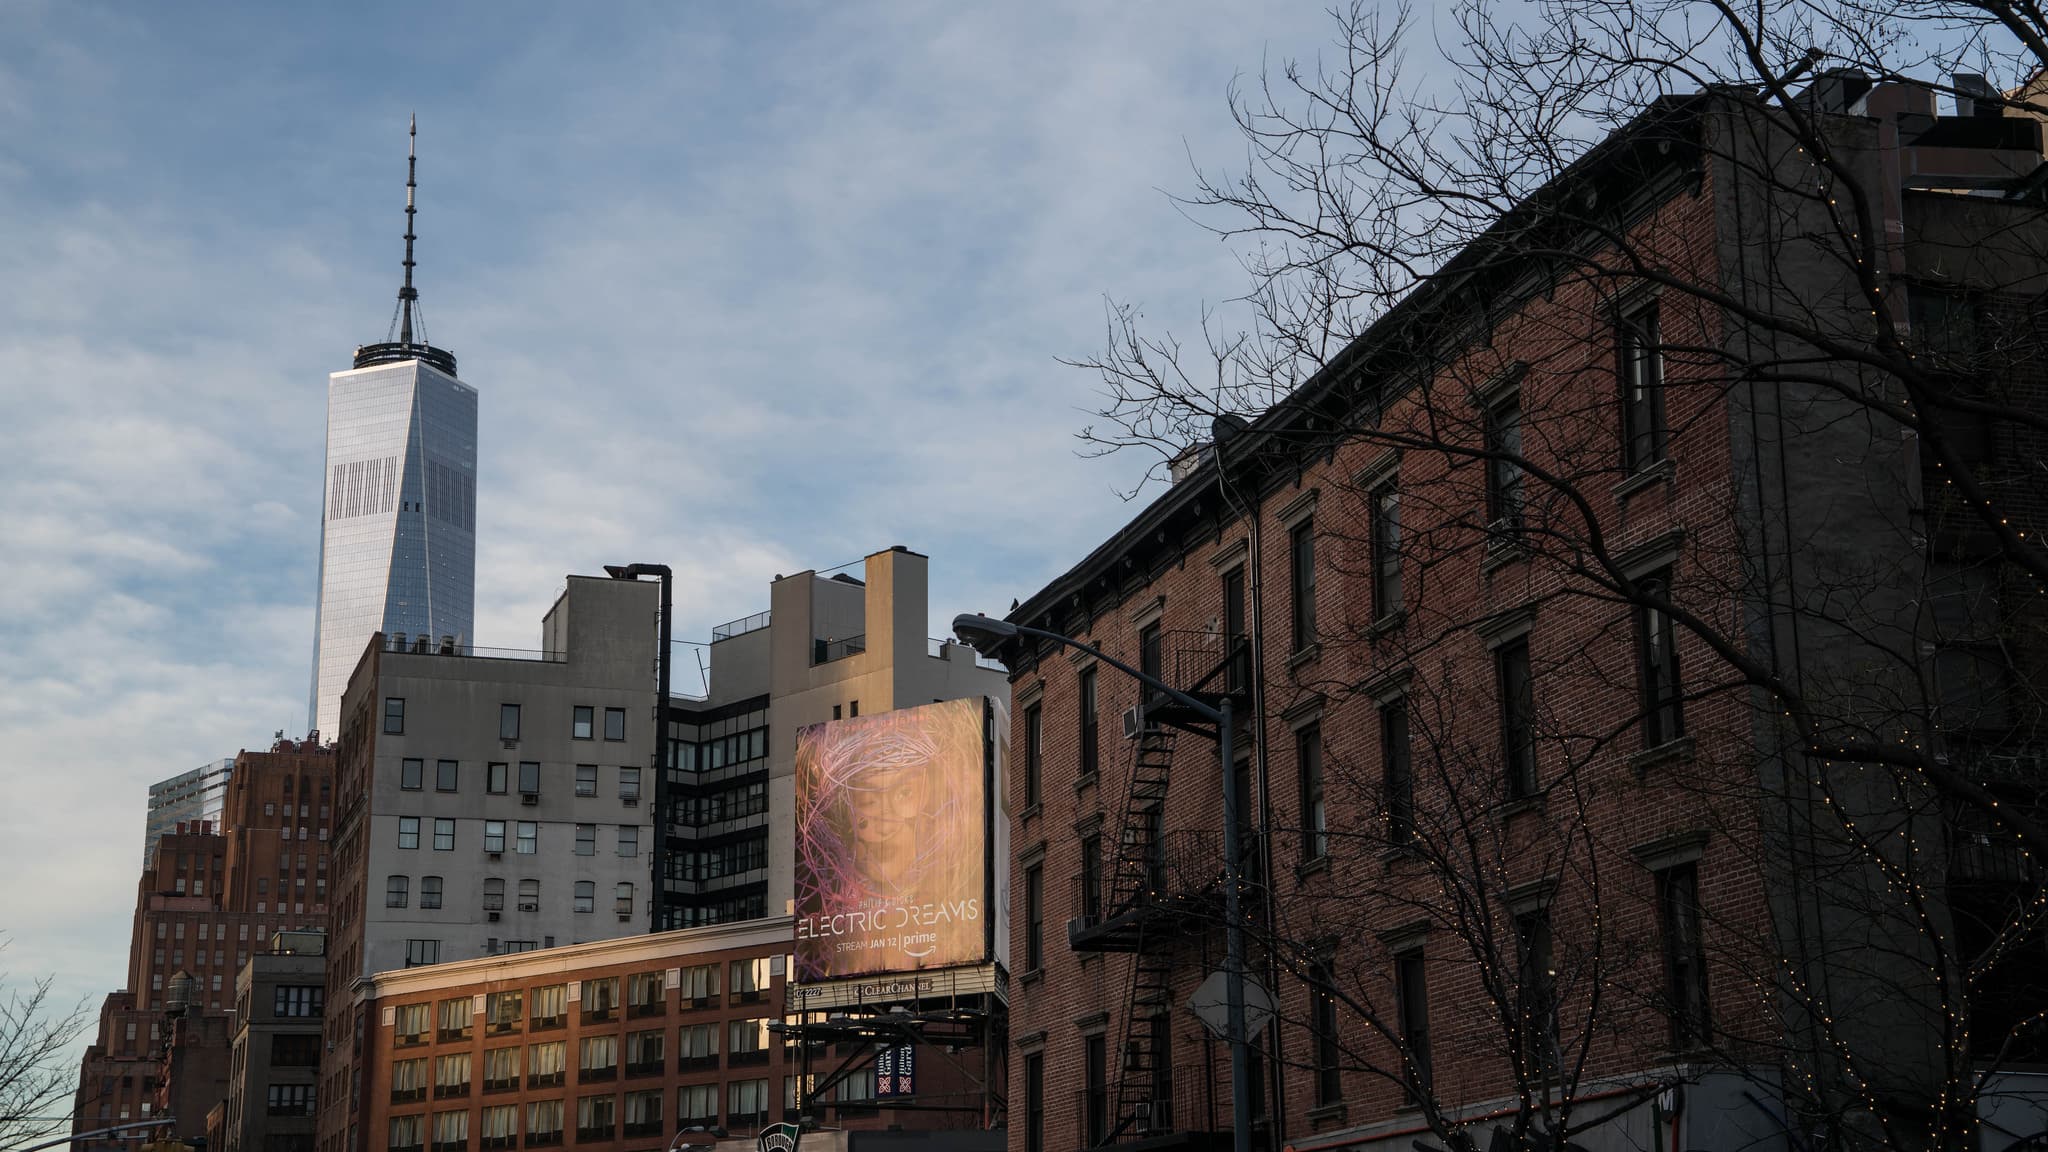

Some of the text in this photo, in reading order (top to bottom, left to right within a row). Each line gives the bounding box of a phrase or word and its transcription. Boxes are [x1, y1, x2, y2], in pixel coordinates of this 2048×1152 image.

[798, 899, 979, 939] ELECTRIC DREAMS
[836, 937, 897, 953] STREAM JAN 12
[903, 932, 937, 948] prime
[904, 1043, 912, 1075] Gard
